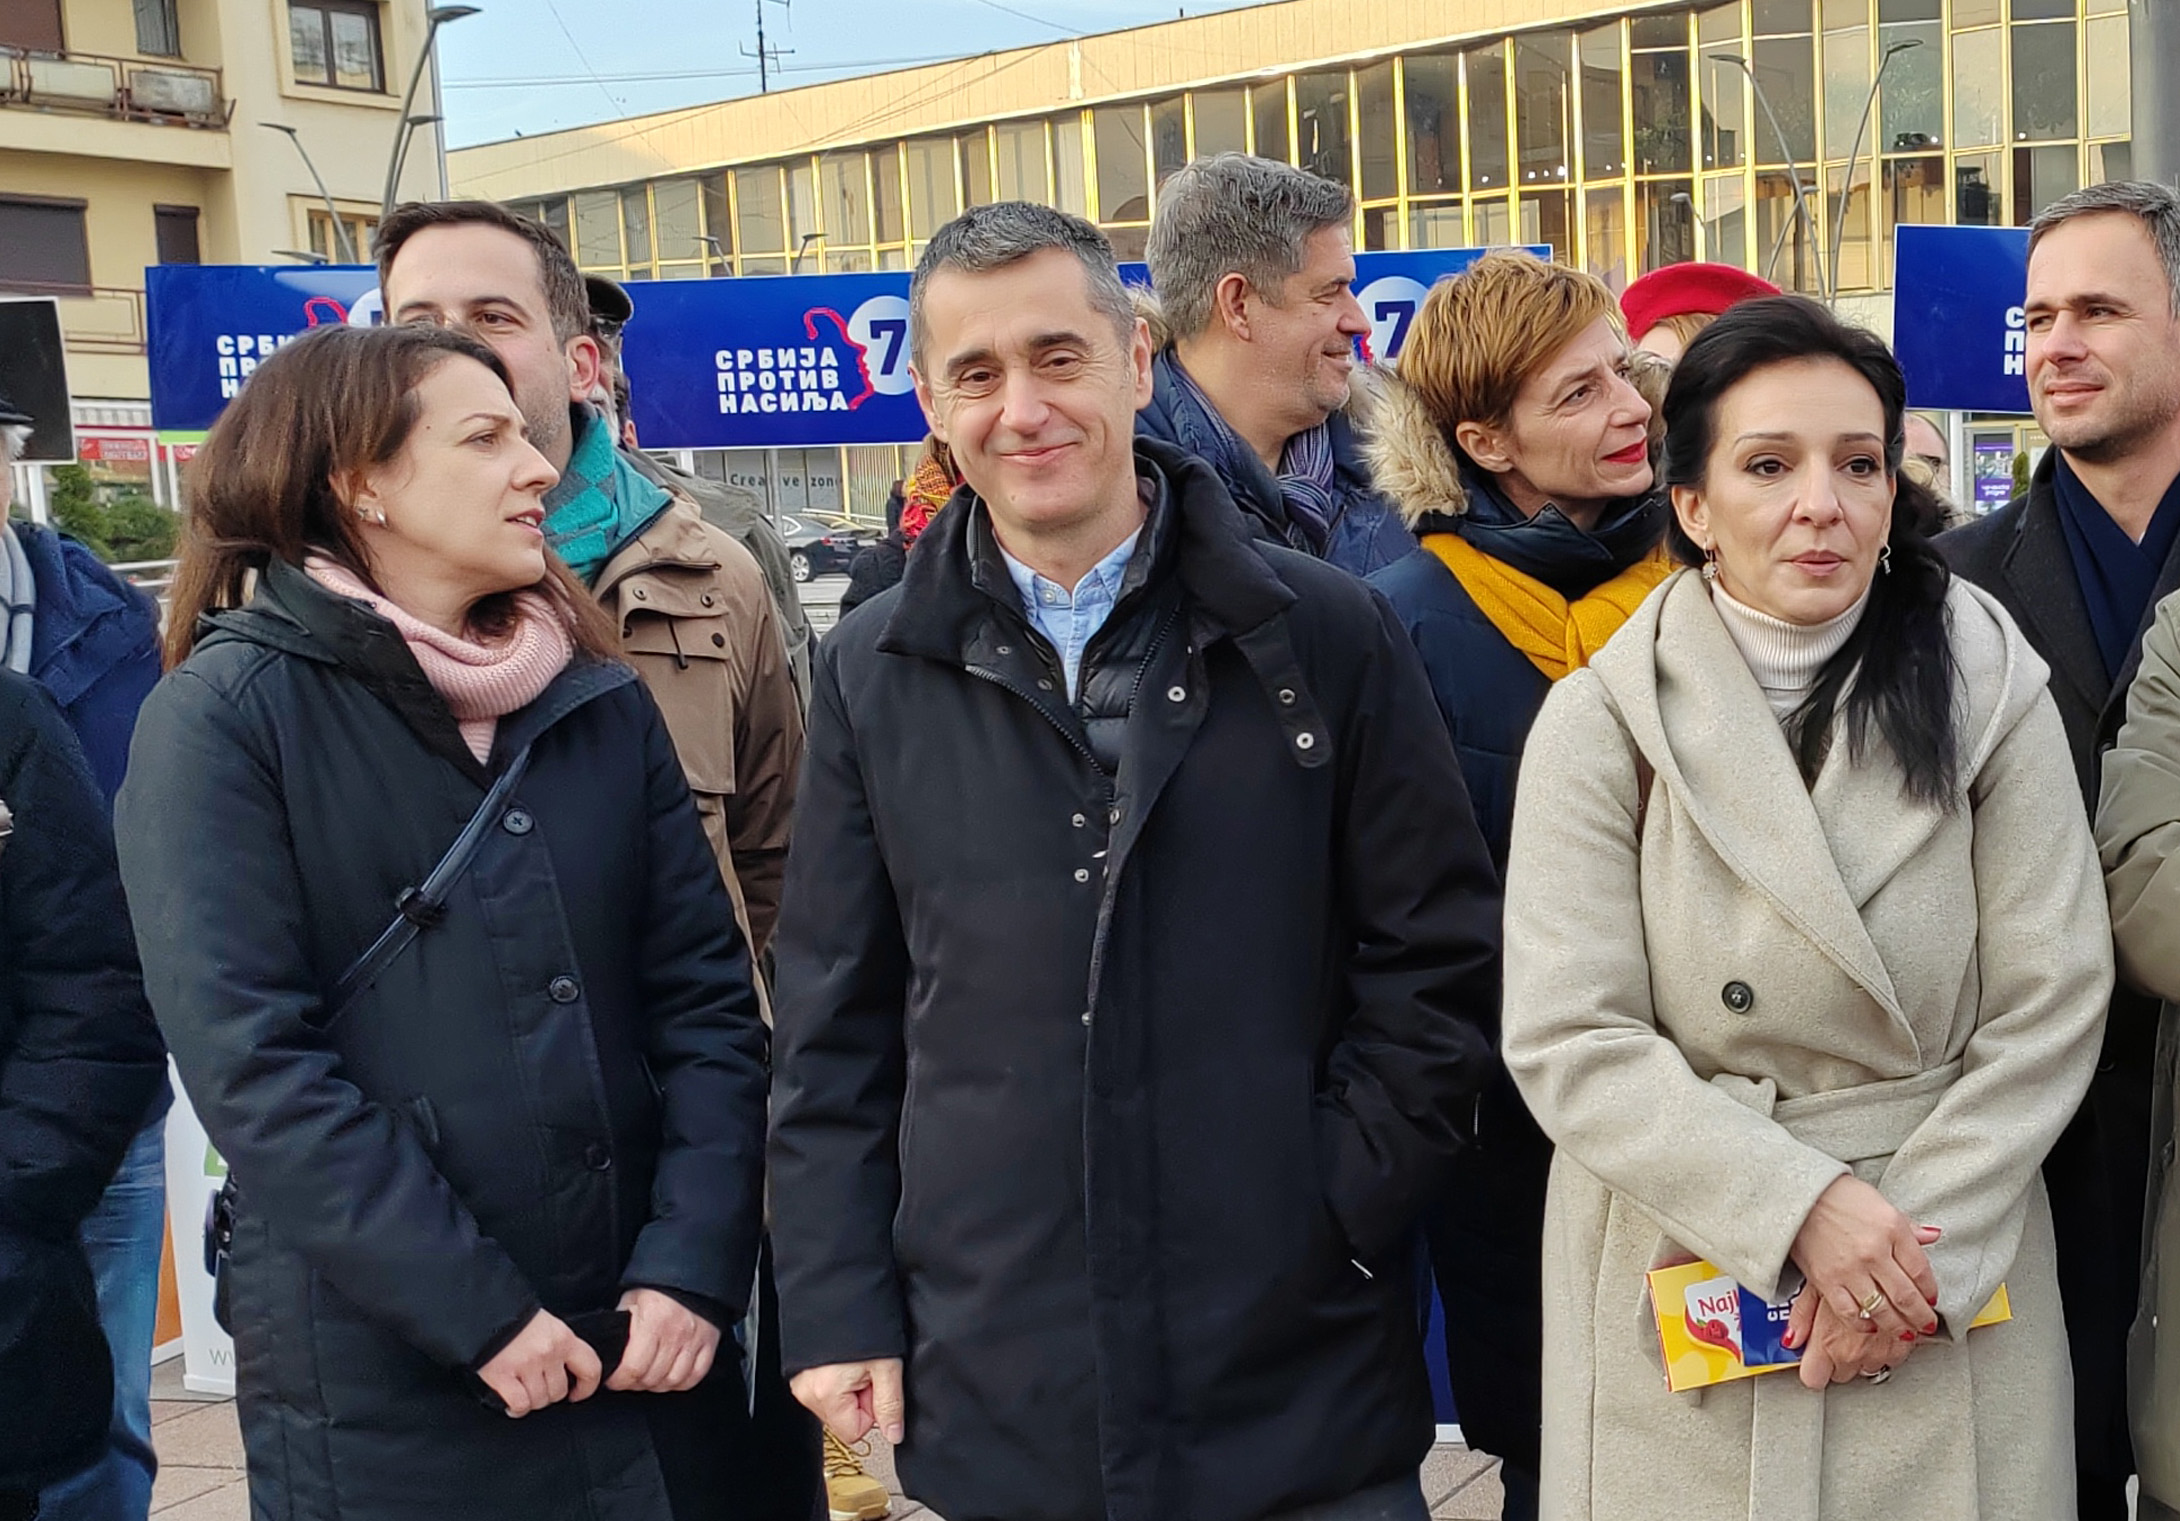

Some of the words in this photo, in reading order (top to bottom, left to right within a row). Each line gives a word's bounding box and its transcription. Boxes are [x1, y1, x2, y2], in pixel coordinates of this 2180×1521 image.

[1375, 300, 1415, 358] 7
[715, 347, 839, 370] СРБИЈА
[717, 369, 839, 392] ПРОТИВ
[719, 391, 849, 414] НАСИЉА
[730, 473, 799, 487] Creave
[810, 475, 838, 487] zon
